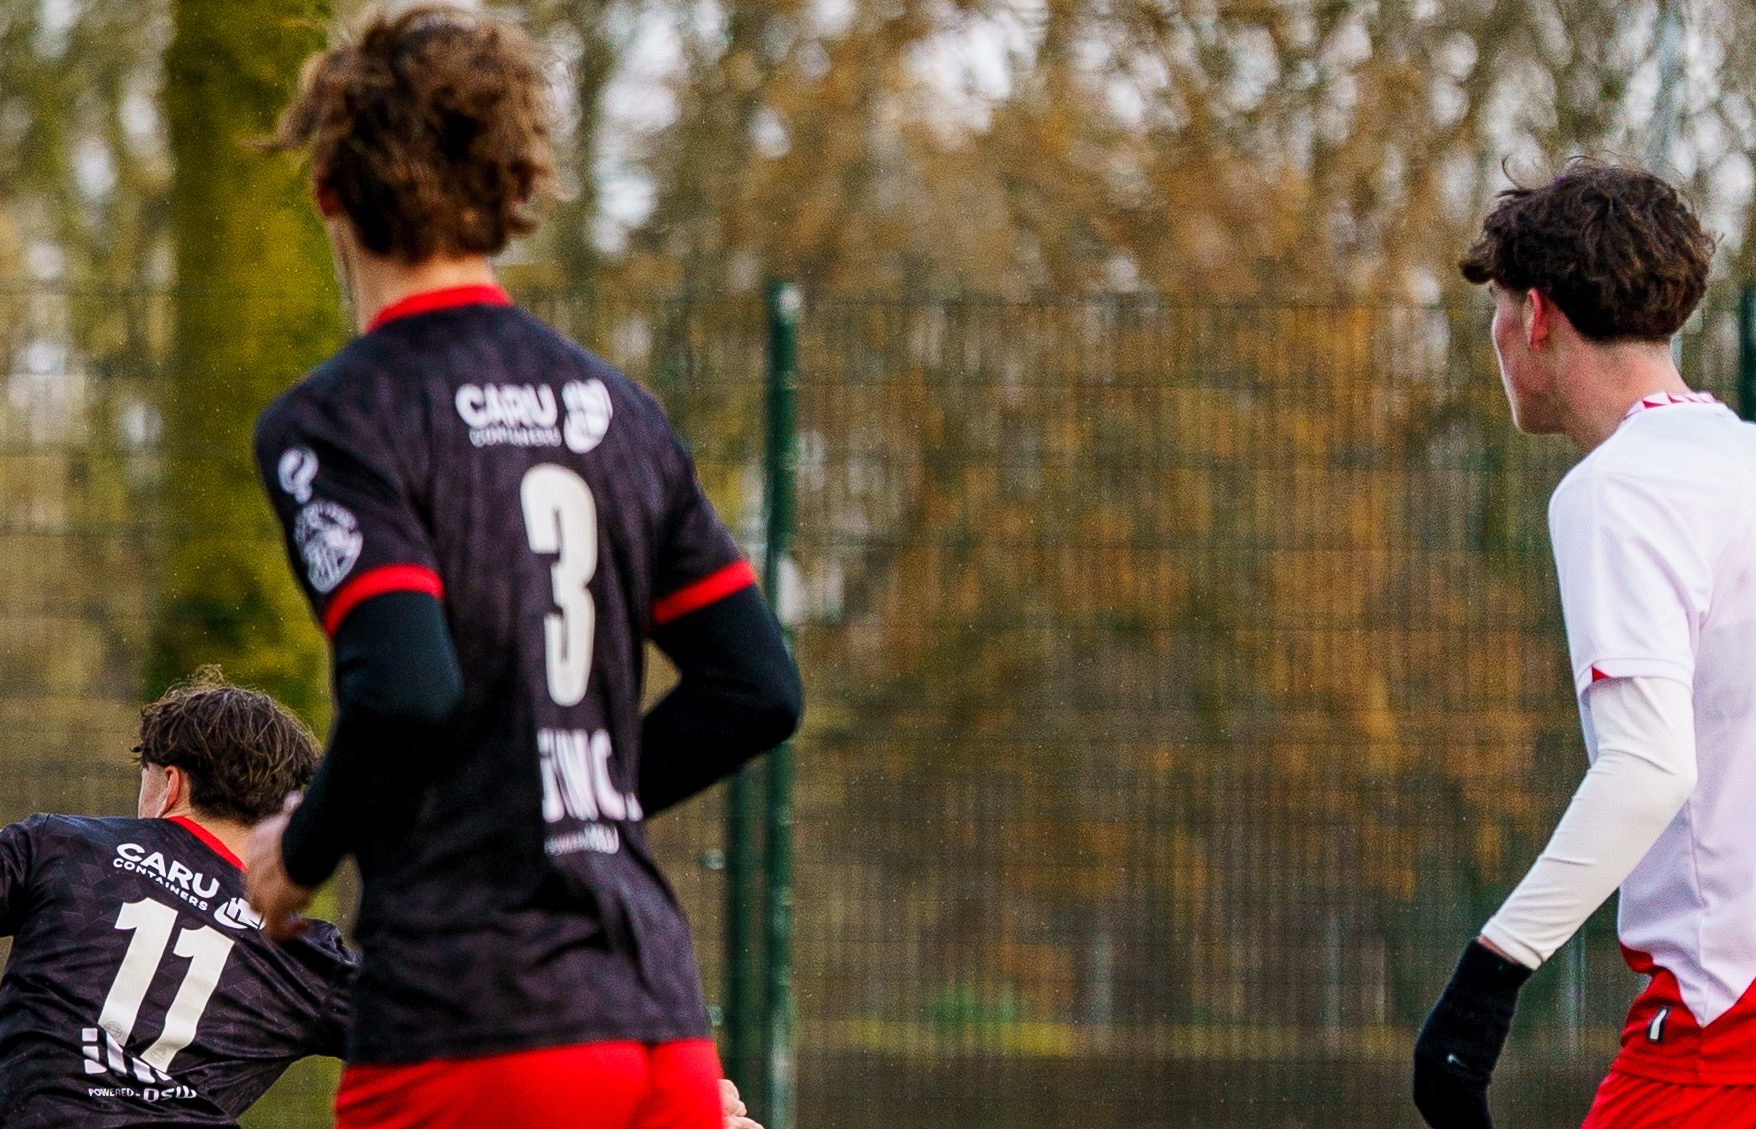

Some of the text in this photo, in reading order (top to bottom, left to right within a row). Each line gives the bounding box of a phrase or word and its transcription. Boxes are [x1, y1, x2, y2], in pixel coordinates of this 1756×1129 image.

[520, 462, 599, 708] 3
[113, 857, 208, 911] CONTAINERS
[116, 842, 220, 898] CARU
[97, 896, 235, 1073] 11
